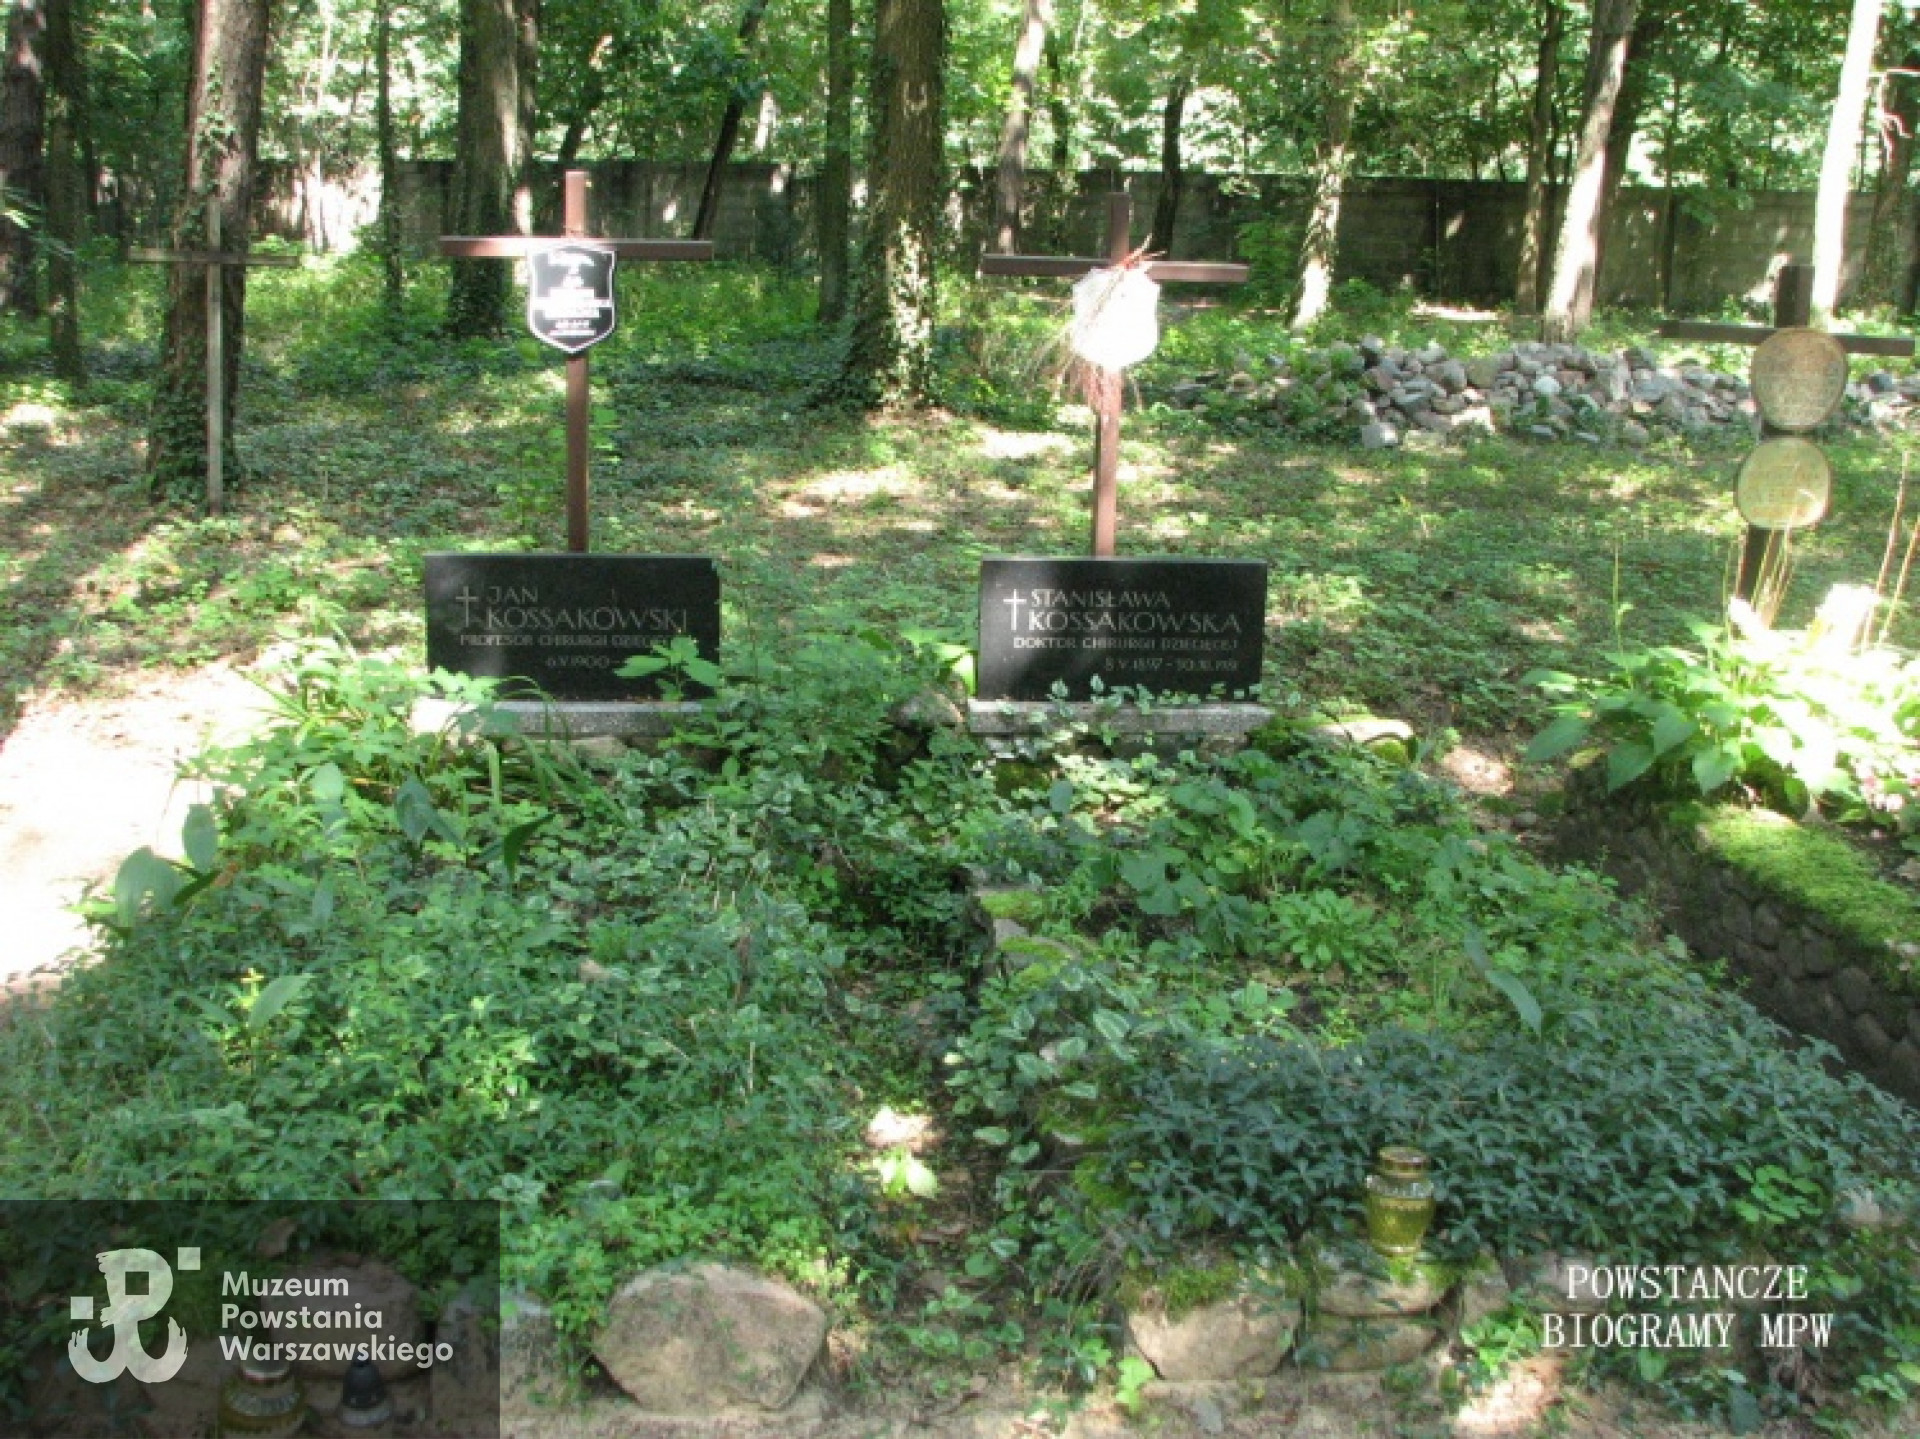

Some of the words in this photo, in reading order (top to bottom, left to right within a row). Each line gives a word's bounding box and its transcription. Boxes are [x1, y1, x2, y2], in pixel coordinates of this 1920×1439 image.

[487, 586, 539, 605] JAN
[1031, 588, 1172, 608] STANISŁAWA
[487, 606, 688, 632] KOSSAKOWSKI
[1027, 610, 1243, 634] KOSSAKOWSKA
[460, 634, 534, 647] PROFESOR
[1013, 636, 1078, 650] DOKTOR
